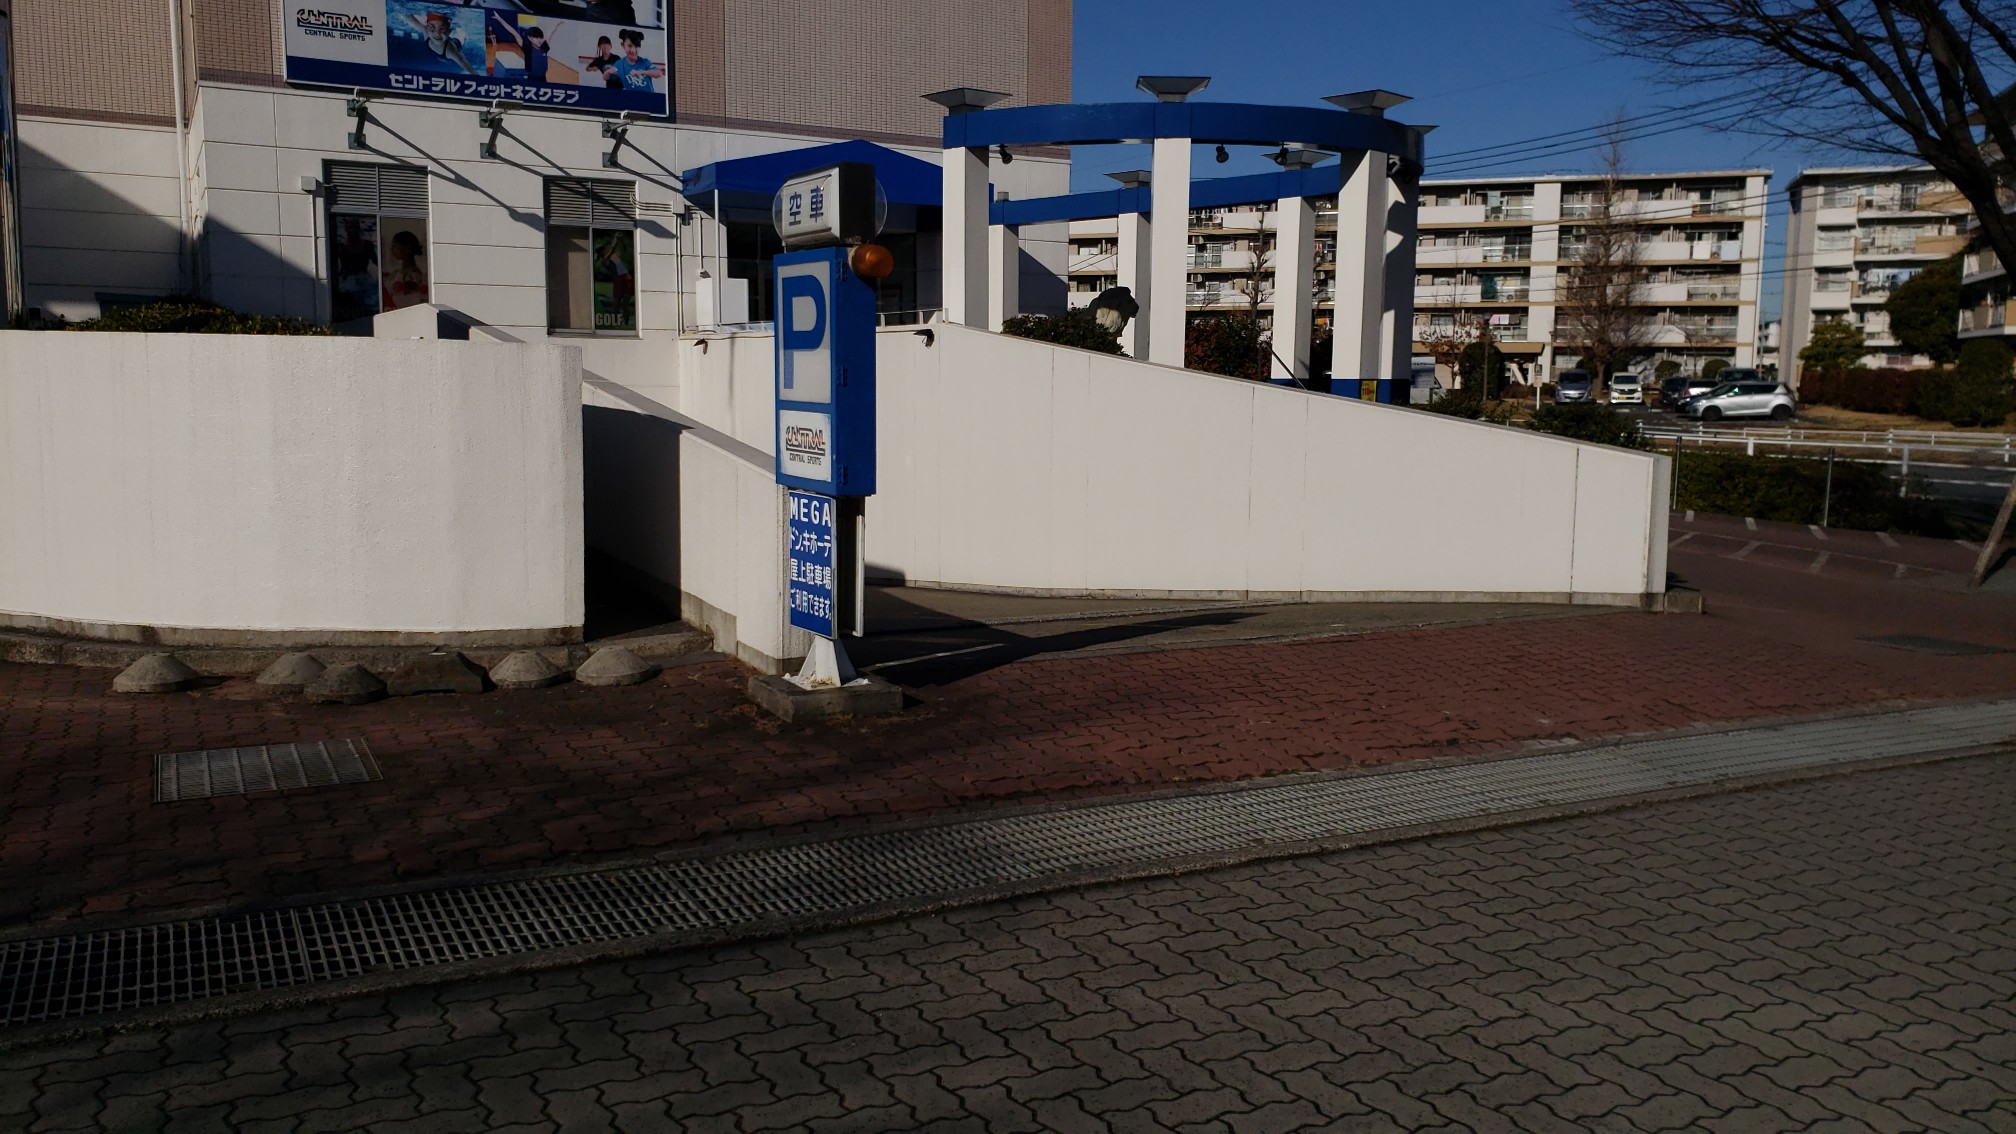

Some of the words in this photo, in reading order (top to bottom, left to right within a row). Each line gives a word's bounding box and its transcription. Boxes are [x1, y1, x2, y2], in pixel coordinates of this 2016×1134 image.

[296, 8, 373, 35] CENTRAL
[304, 28, 335, 38] CENTRAL
[339, 33, 366, 41] SPORTS
[389, 73, 460, 93] セントラル
[464, 80, 580, 104] フィットネスクラブ
[788, 184, 824, 227] 空車
[595, 312, 625, 327] GOLF
[781, 274, 827, 390] P
[785, 425, 826, 456] CENTRAL
[789, 496, 831, 528] MEGA
[790, 558, 831, 590] 屋上駐車場
[790, 588, 832, 620] ご利用できます。
